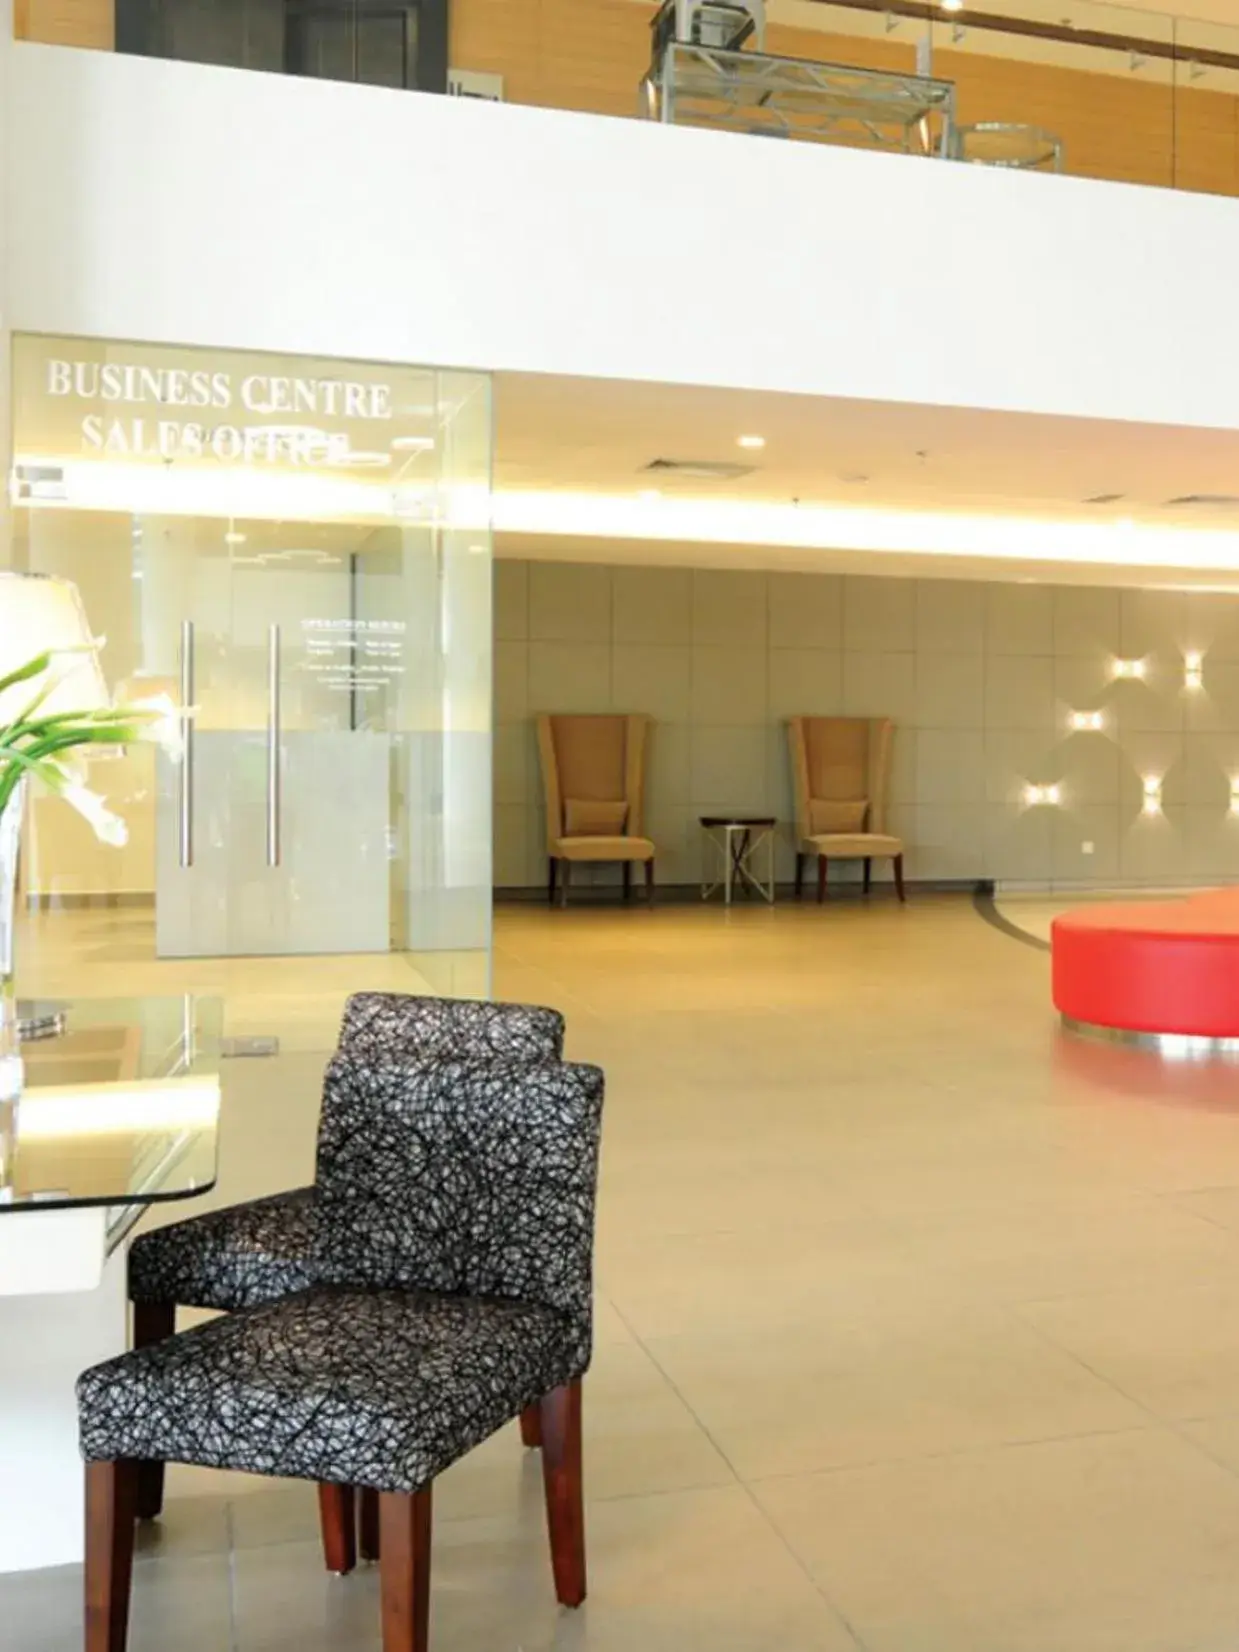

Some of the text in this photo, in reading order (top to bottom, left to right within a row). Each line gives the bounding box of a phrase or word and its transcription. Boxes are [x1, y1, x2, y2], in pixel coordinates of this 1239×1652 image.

[47, 359, 393, 418] BUSINESS CENTRE
[81, 414, 203, 457] SALES
